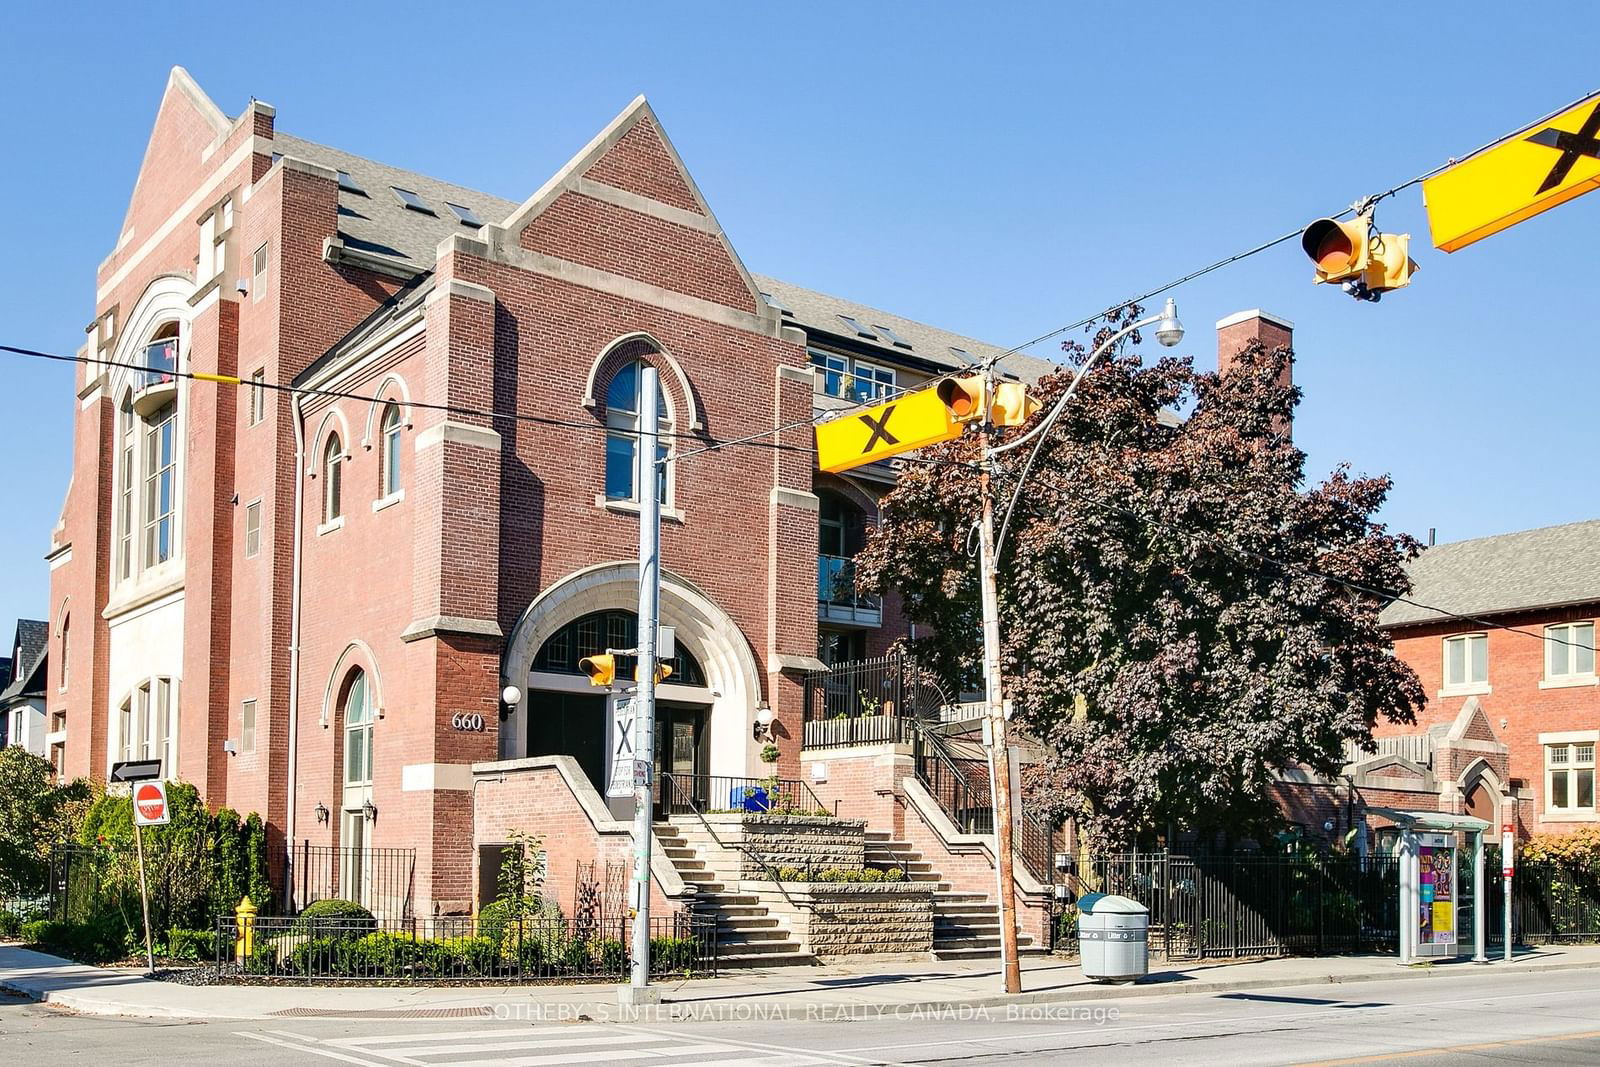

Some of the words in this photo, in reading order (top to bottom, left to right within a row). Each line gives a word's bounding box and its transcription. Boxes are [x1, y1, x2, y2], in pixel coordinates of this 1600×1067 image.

[858, 405, 900, 453] X
[452, 711, 482, 730] 660
[616, 719, 633, 754] X
[1078, 931, 1091, 939] Litter
[1107, 931, 1122, 939] Litter
